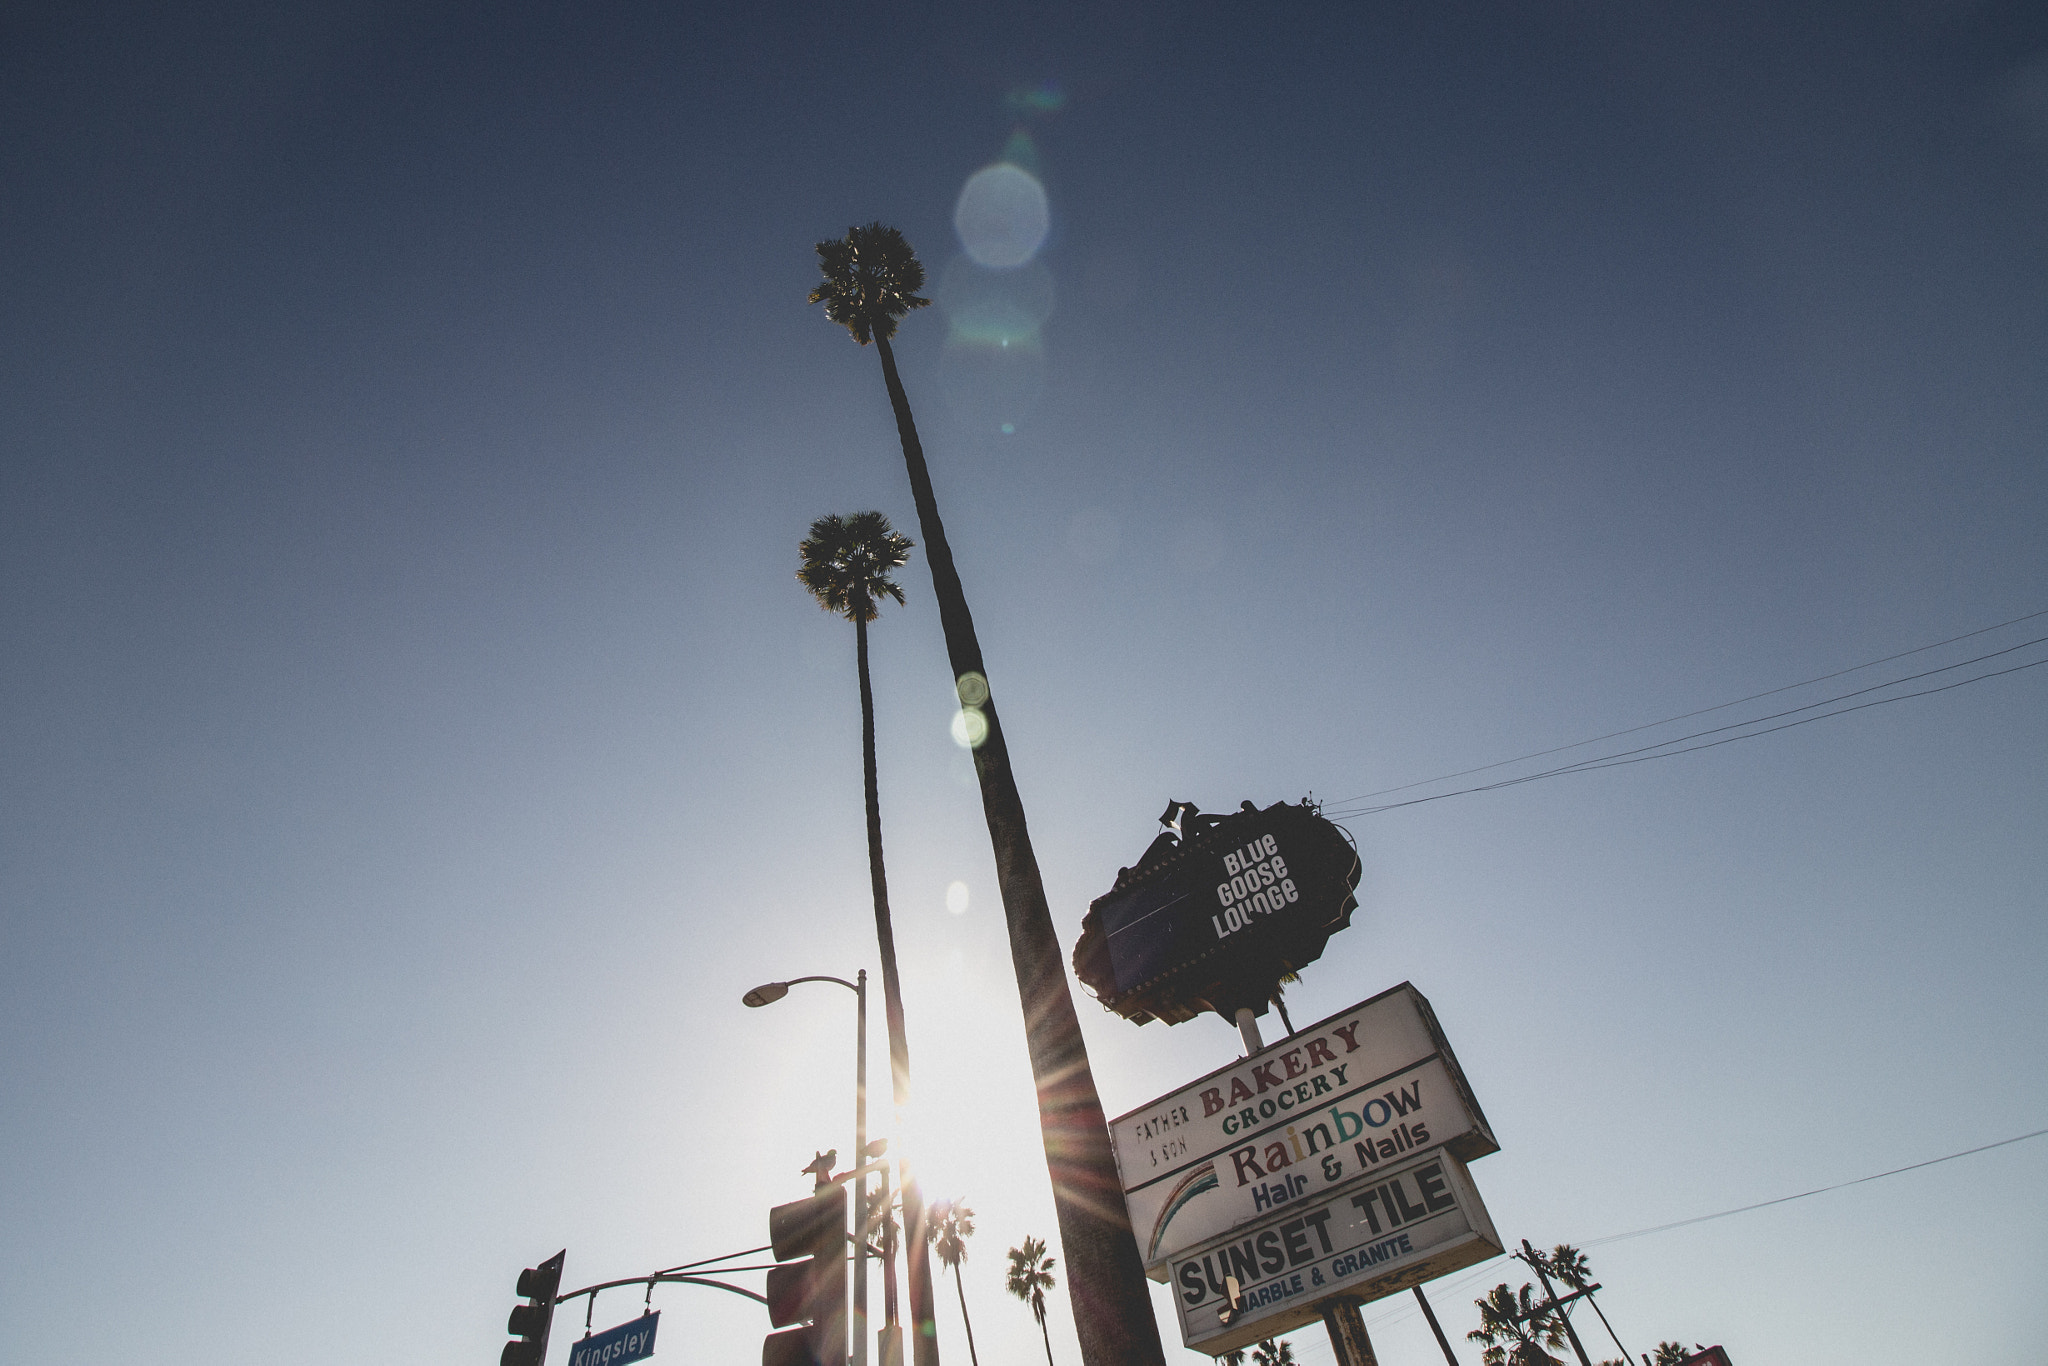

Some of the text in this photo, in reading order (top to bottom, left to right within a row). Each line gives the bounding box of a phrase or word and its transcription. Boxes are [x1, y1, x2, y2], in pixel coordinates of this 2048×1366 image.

[1216, 855, 1288, 906] GOOSE
[1223, 833, 1278, 876] BLUE
[1199, 1020, 1363, 1118] BAKERY
[1222, 1063, 1348, 1135] GROCERY
[1136, 1106, 1189, 1144] FATHER
[1229, 1080, 1424, 1187] Rainbow
[1251, 1121, 1430, 1212] Hair & Nails
[1179, 1163, 1455, 1304] SUNSET TILE
[1311, 1267, 1325, 1286] &
[1332, 1233, 1413, 1278] GRANITE
[575, 1330, 649, 1366] Kingsley
